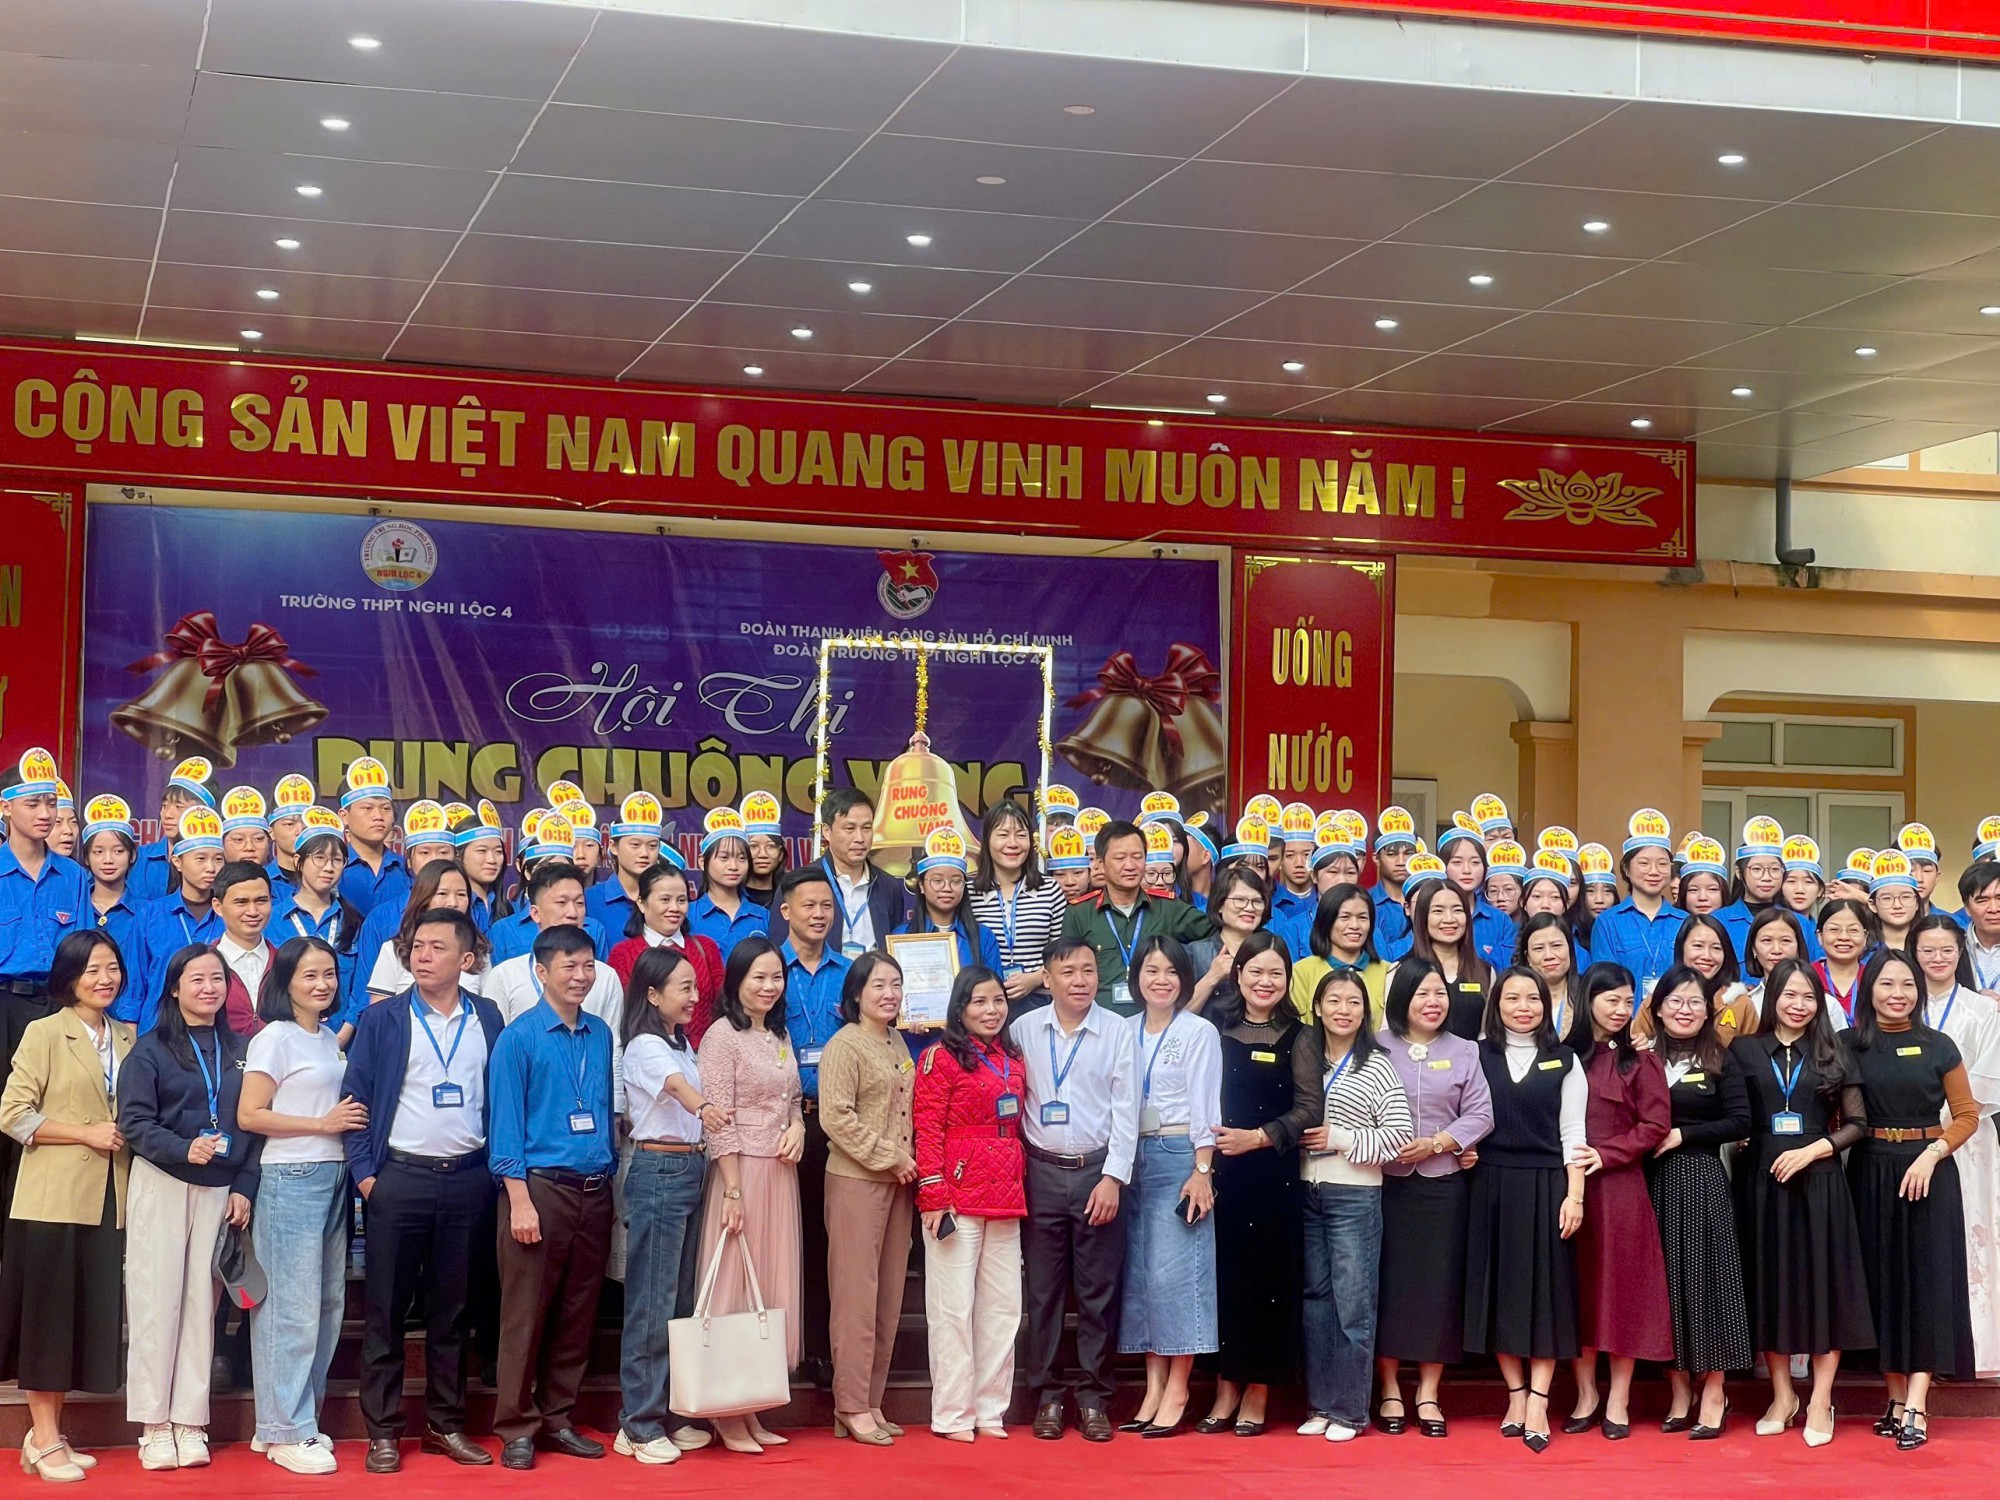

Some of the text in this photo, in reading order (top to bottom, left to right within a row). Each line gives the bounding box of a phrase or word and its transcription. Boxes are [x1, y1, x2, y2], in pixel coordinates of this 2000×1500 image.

[15, 368, 204, 453] CỘNG
[229, 375, 368, 457] SẢN
[387, 395, 525, 477] VIỆT
[547, 414, 696, 477] NAM
[717, 425, 925, 491] QUANG
[942, 440, 1082, 499] VINH
[1105, 442, 1280, 511] MUÔN
[1299, 448, 1436, 518] NĂM
[280, 593, 513, 618] TRƯỜNG THPT NGHI LỘC 4
[740, 621, 786, 637] ĐOÀN
[791, 625, 844, 639] THANH
[1001, 631, 1028, 646] CHÍ
[1033, 634, 1073, 646] MINH
[945, 651, 986, 664] NGHI
[1031, 654, 1040, 665] 4
[1272, 616, 1353, 688] UỐNG
[505, 661, 683, 735] Hội
[1267, 723, 1353, 793] NƯỚC
[26, 766, 54, 779] 030
[176, 767, 204, 780] 012
[316, 737, 523, 802] RUNG
[536, 737, 830, 814] CHUÔNG
[354, 773, 384, 785] 011
[280, 791, 311, 804] 018
[892, 785, 927, 800] RUNG
[1049, 795, 1075, 806] 056
[1146, 802, 1174, 812] 037
[92, 808, 124, 820] 055
[228, 803, 260, 815] 022
[627, 809, 657, 822] 040
[746, 809, 776, 820] 005
[894, 801, 948, 820] CHUÔNG
[1477, 806, 1504, 820] 072
[310, 815, 338, 827] 026
[409, 817, 440, 831] 027
[711, 818, 741, 829] 008
[1285, 818, 1311, 829] 006
[1384, 820, 1410, 831] 070
[187, 822, 219, 835] 019
[1636, 823, 1664, 834] 003
[543, 830, 572, 843] 038
[1545, 838, 1573, 848] 063
[1750, 831, 1778, 843] 002
[931, 841, 961, 855] 032
[1055, 842, 1082, 855] 071
[1786, 848, 1813, 859] 001
[1492, 853, 1520, 864] 066
[1691, 851, 1720, 862] 053
[1413, 861, 1440, 871] 051
[1876, 862, 1906, 875] 009
[1719, 1008, 1737, 1028] A
